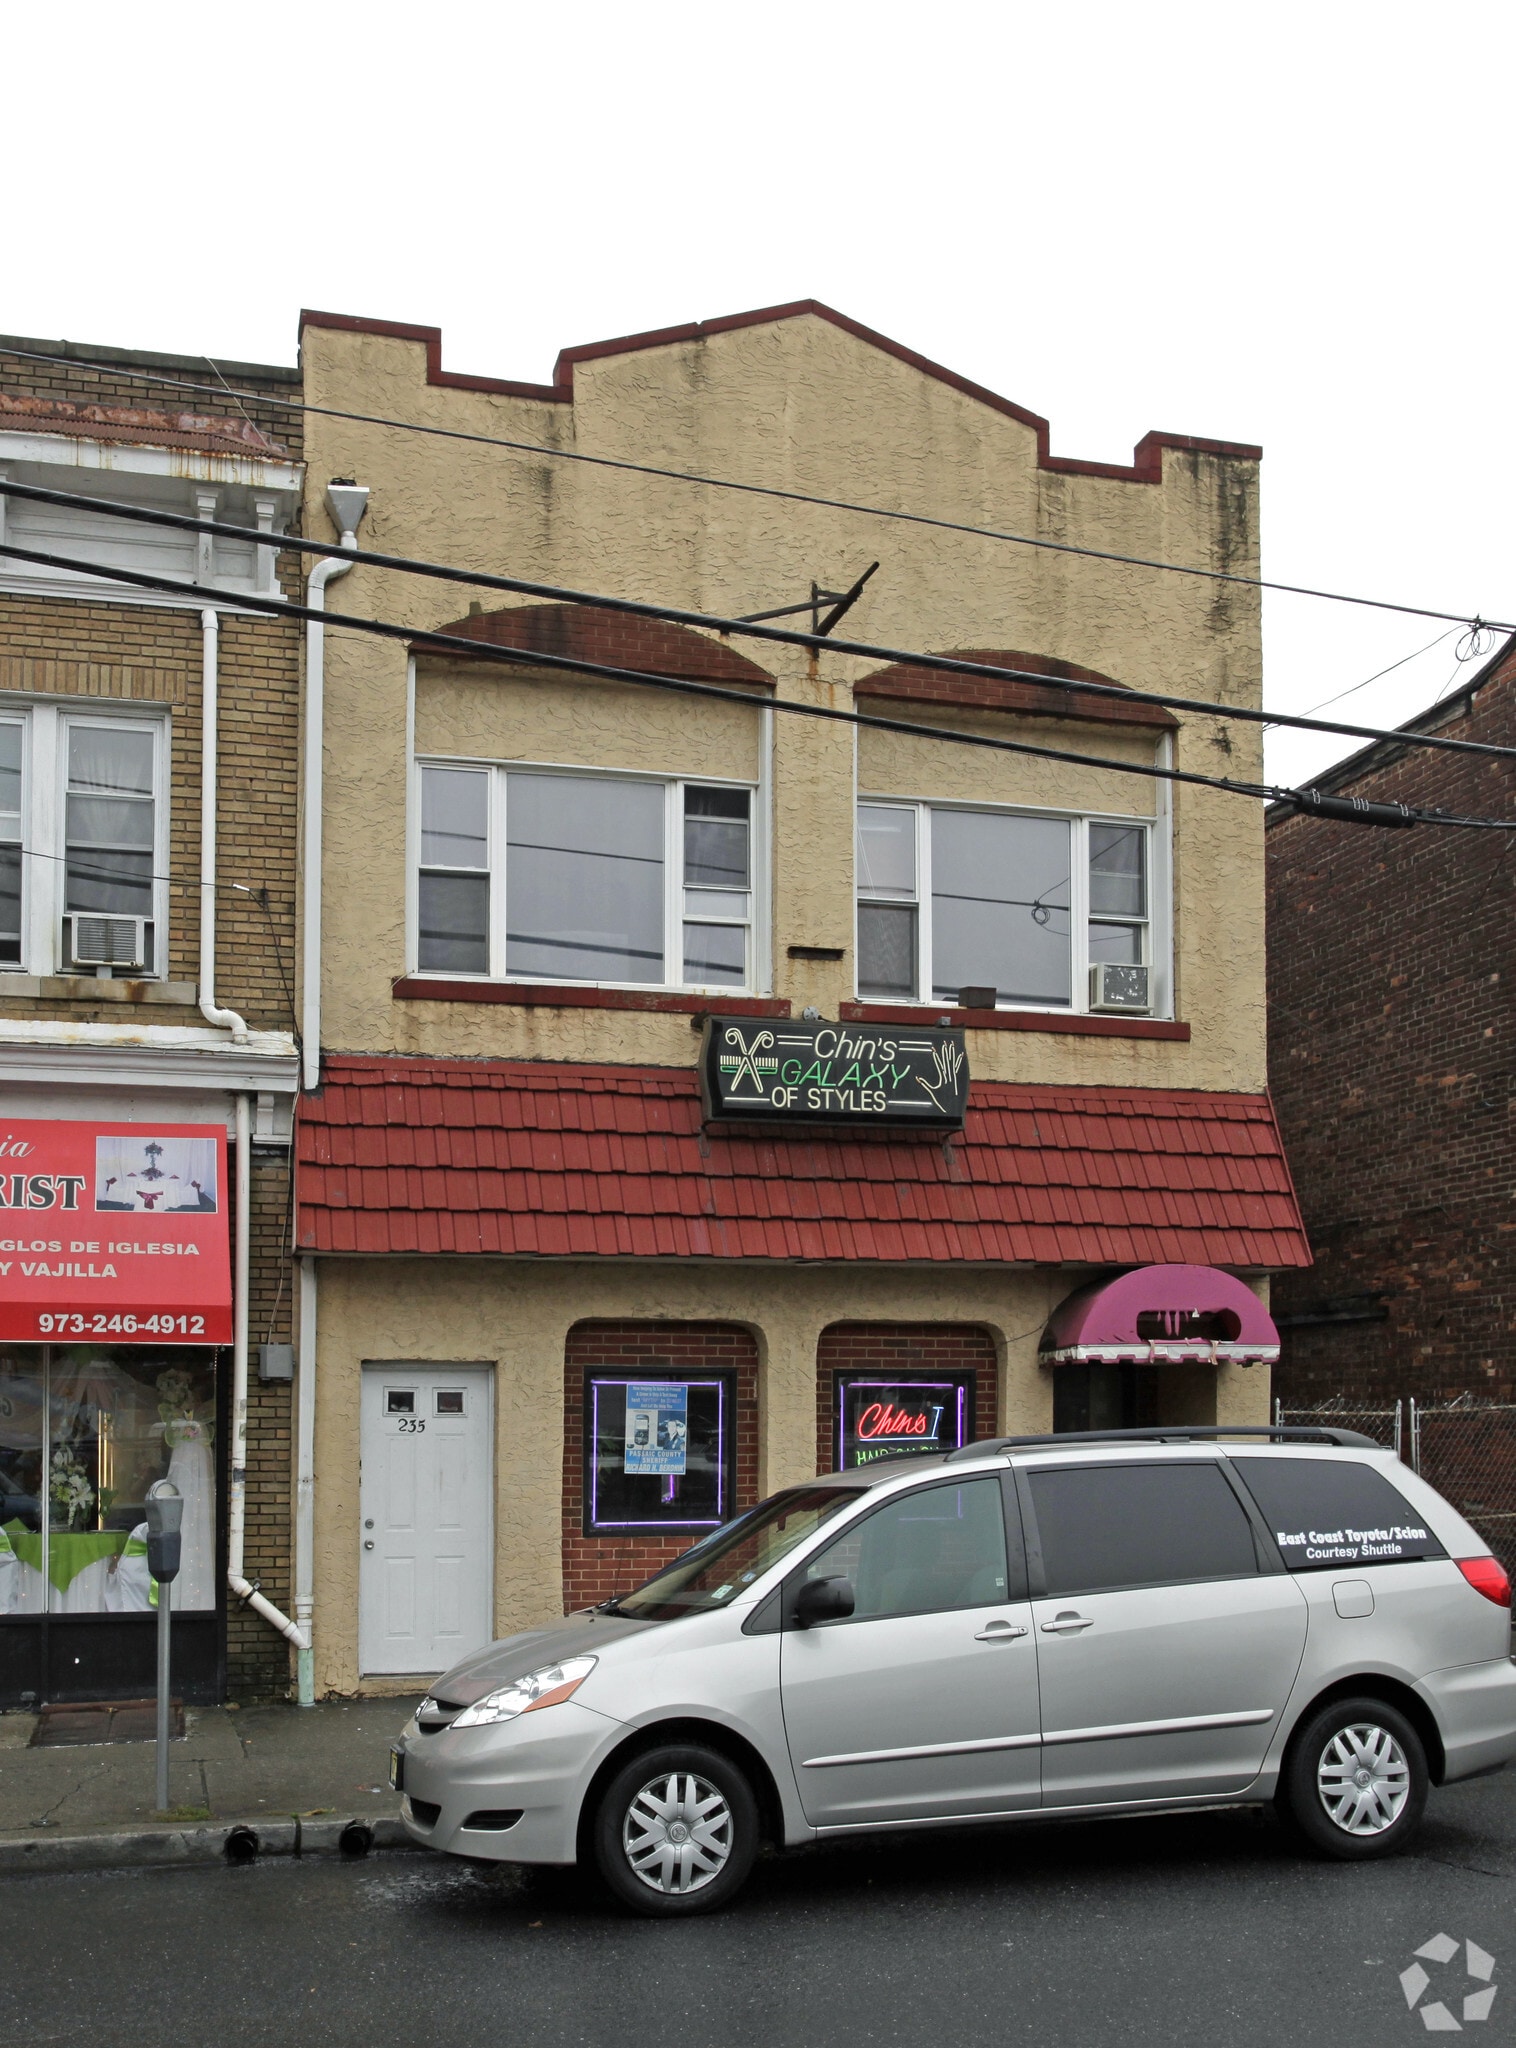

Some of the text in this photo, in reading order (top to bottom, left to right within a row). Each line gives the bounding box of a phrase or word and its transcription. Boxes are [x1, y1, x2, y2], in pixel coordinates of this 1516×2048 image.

[815, 1029, 897, 1061] Chin's
[781, 1059, 911, 1089] GALAXY
[771, 1086, 887, 1112] OF STYLES
[70, 1241, 100, 1253] DE
[108, 1242, 200, 1256] IGLESIA
[0, 1262, 118, 1278] Y VAJILLA
[39, 1314, 205, 1334] 973-246-4912
[398, 1418, 426, 1433] 235
[1277, 1526, 1427, 1546] East Coast Toyota/Scion
[1306, 1543, 1402, 1559] Courtesy Shuttle
